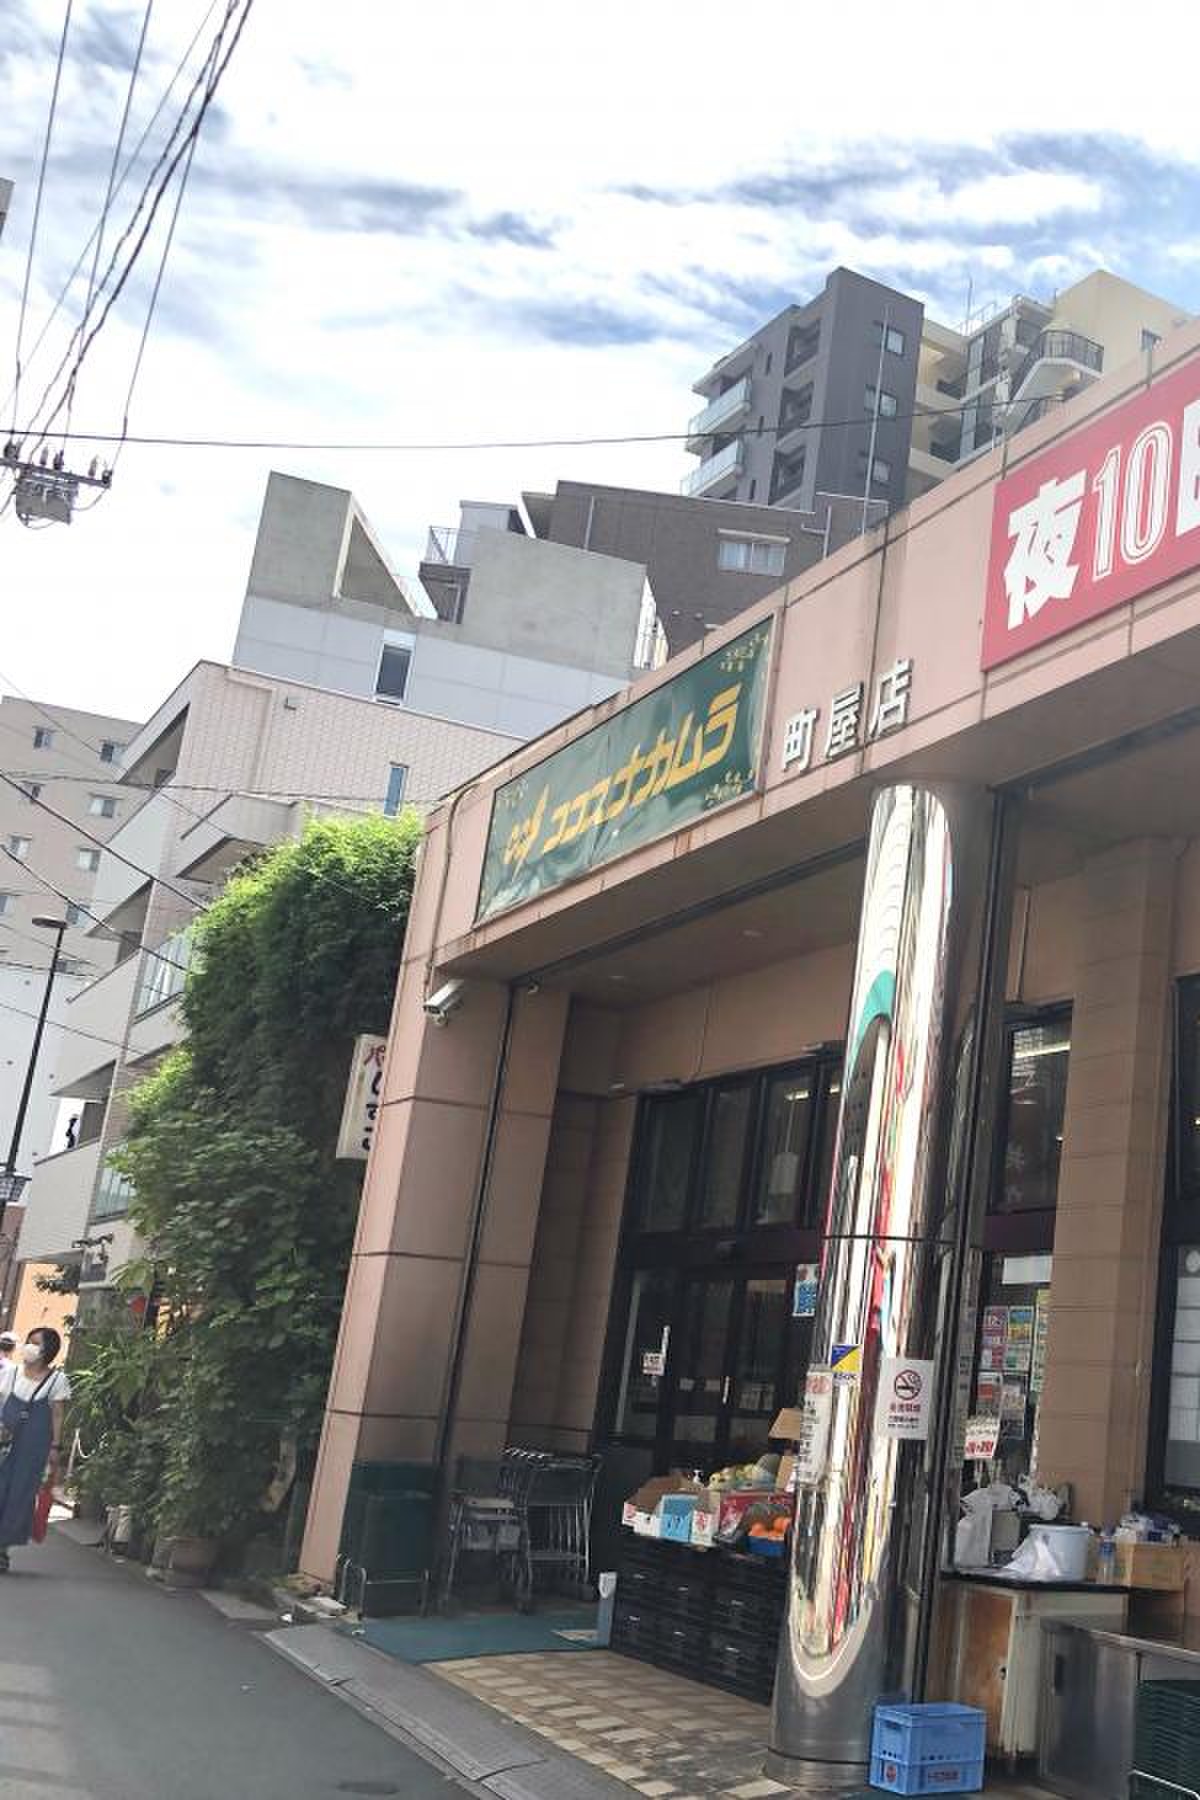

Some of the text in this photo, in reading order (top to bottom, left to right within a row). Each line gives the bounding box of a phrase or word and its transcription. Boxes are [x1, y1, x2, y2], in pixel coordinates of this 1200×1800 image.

[542, 682, 742, 854] ココスナカムラ
[783, 657, 913, 772] 町屋店
